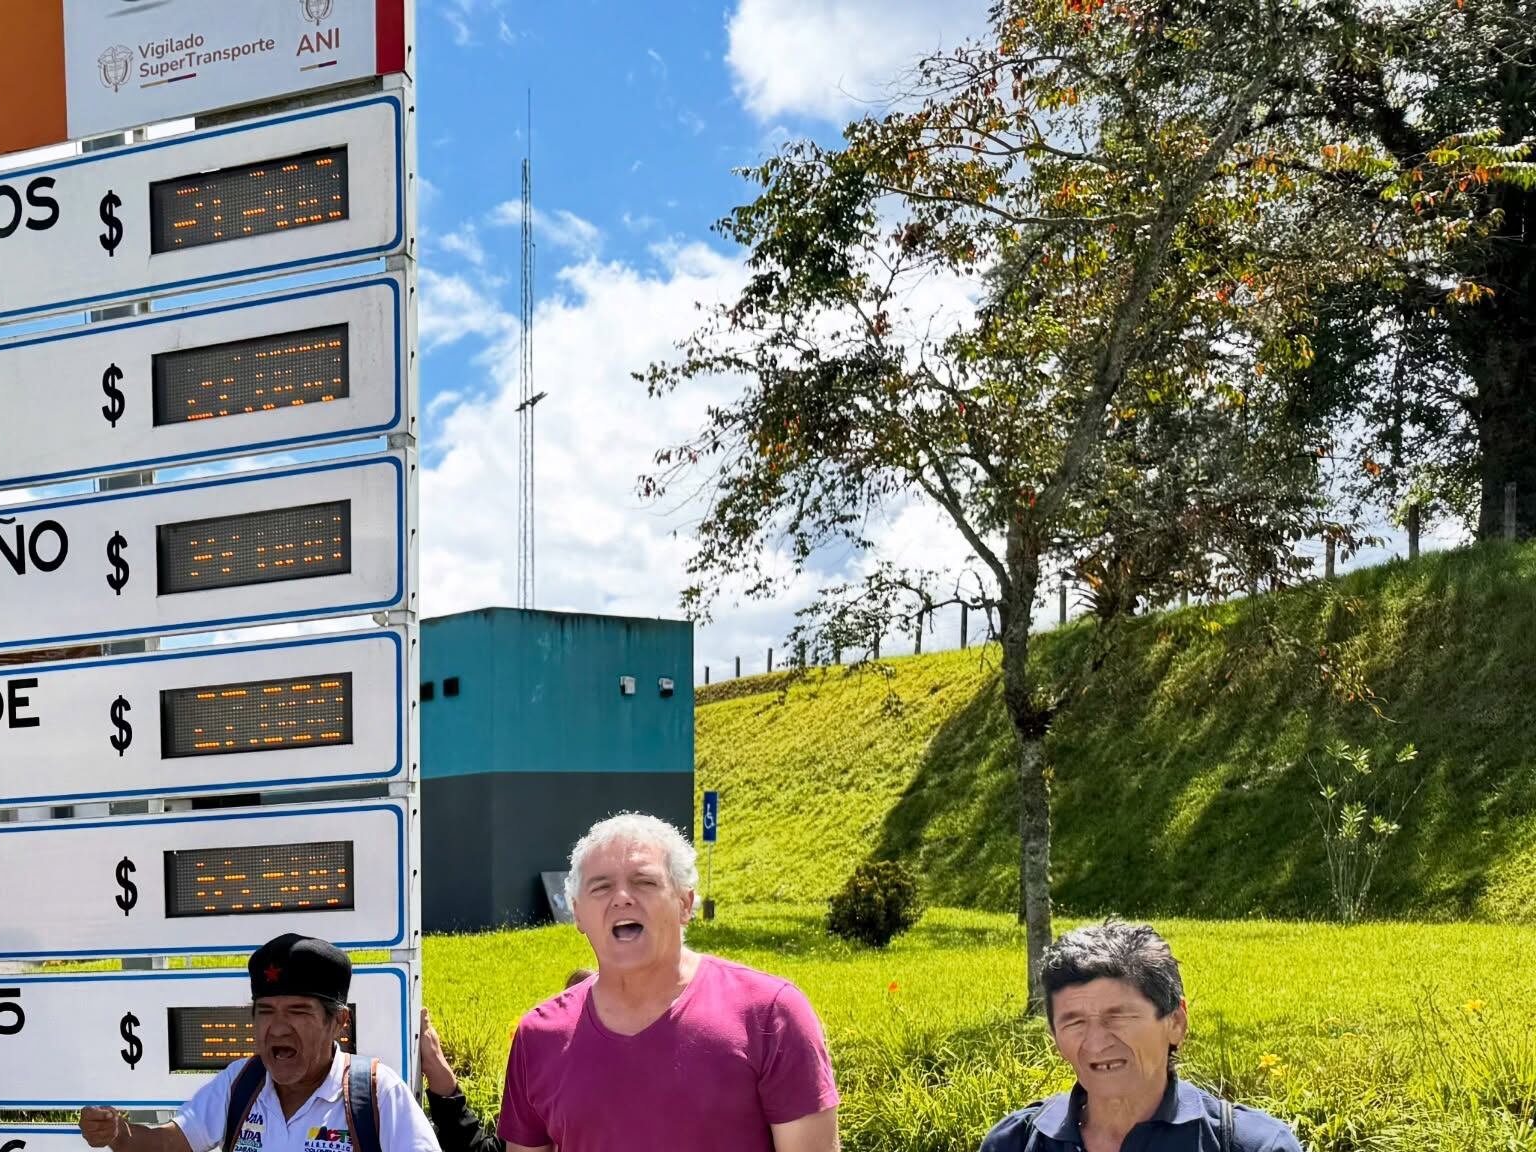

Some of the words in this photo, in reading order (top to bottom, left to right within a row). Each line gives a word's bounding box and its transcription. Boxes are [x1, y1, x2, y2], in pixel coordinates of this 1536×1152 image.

[138, 33, 204, 60] Vigilado
[138, 36, 275, 78] SuperTransporte
[296, 27, 340, 57] ANI
[99, 189, 124, 257] $
[101, 363, 126, 428] $
[106, 530, 130, 596] $
[109, 694, 133, 757] $
[115, 856, 139, 916] $
[120, 1011, 143, 1071] $
